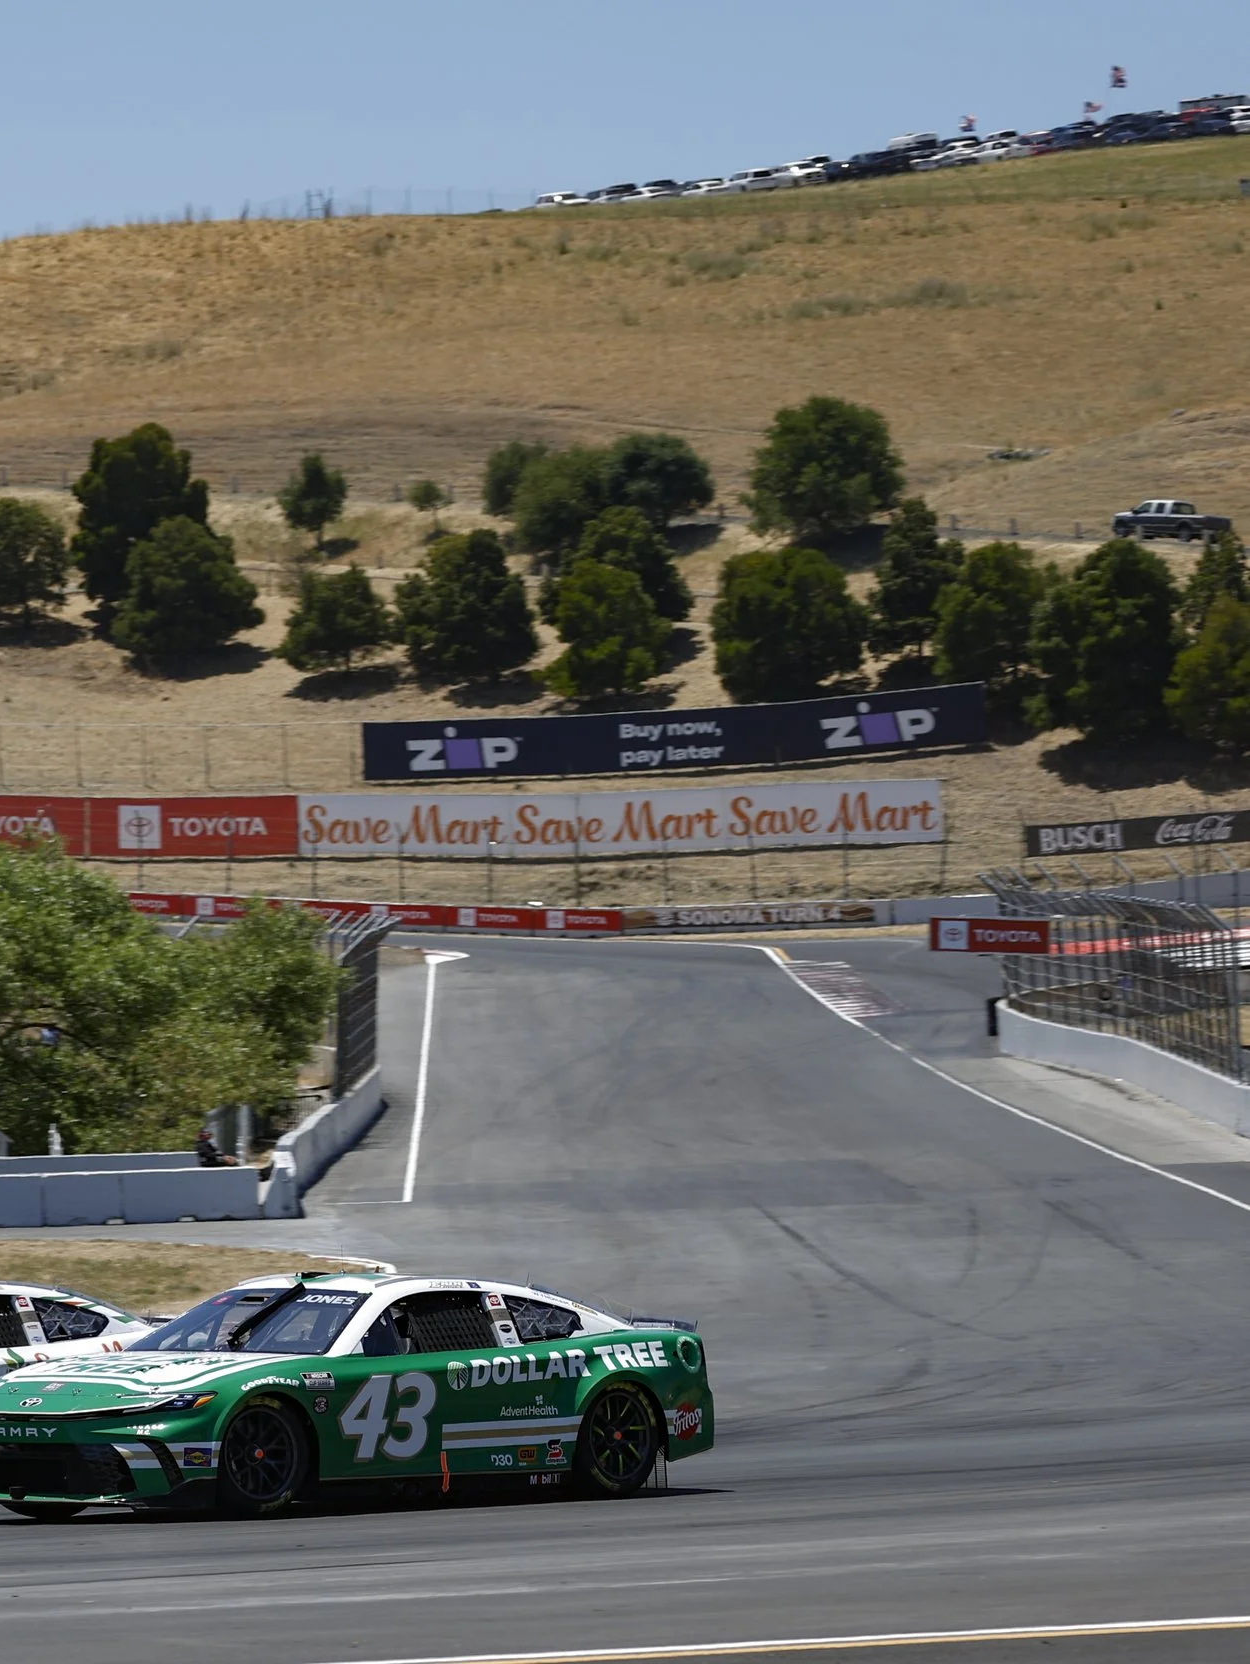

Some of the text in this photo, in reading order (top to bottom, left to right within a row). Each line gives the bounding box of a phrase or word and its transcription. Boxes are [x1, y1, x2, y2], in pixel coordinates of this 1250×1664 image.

[618, 721, 723, 742] Buy now,
[619, 744, 725, 767] pay later
[302, 804, 507, 845] Save Mart
[513, 799, 721, 844] Save Mart
[728, 791, 938, 836] Save Mart
[168, 815, 268, 837] TOYOTA
[1039, 822, 1124, 852] BUSCH
[676, 909, 765, 926] SONOMA
[769, 907, 823, 922] TURN
[973, 928, 1042, 944] TOYOTA
[296, 1294, 358, 1305] JONES
[469, 1340, 669, 1388] DOLLAR TREE
[241, 1376, 300, 1391] GOODYEAR
[340, 1371, 437, 1460] 43
[500, 1404, 559, 1416] AdventHealth
[673, 1408, 701, 1436] Fritos
